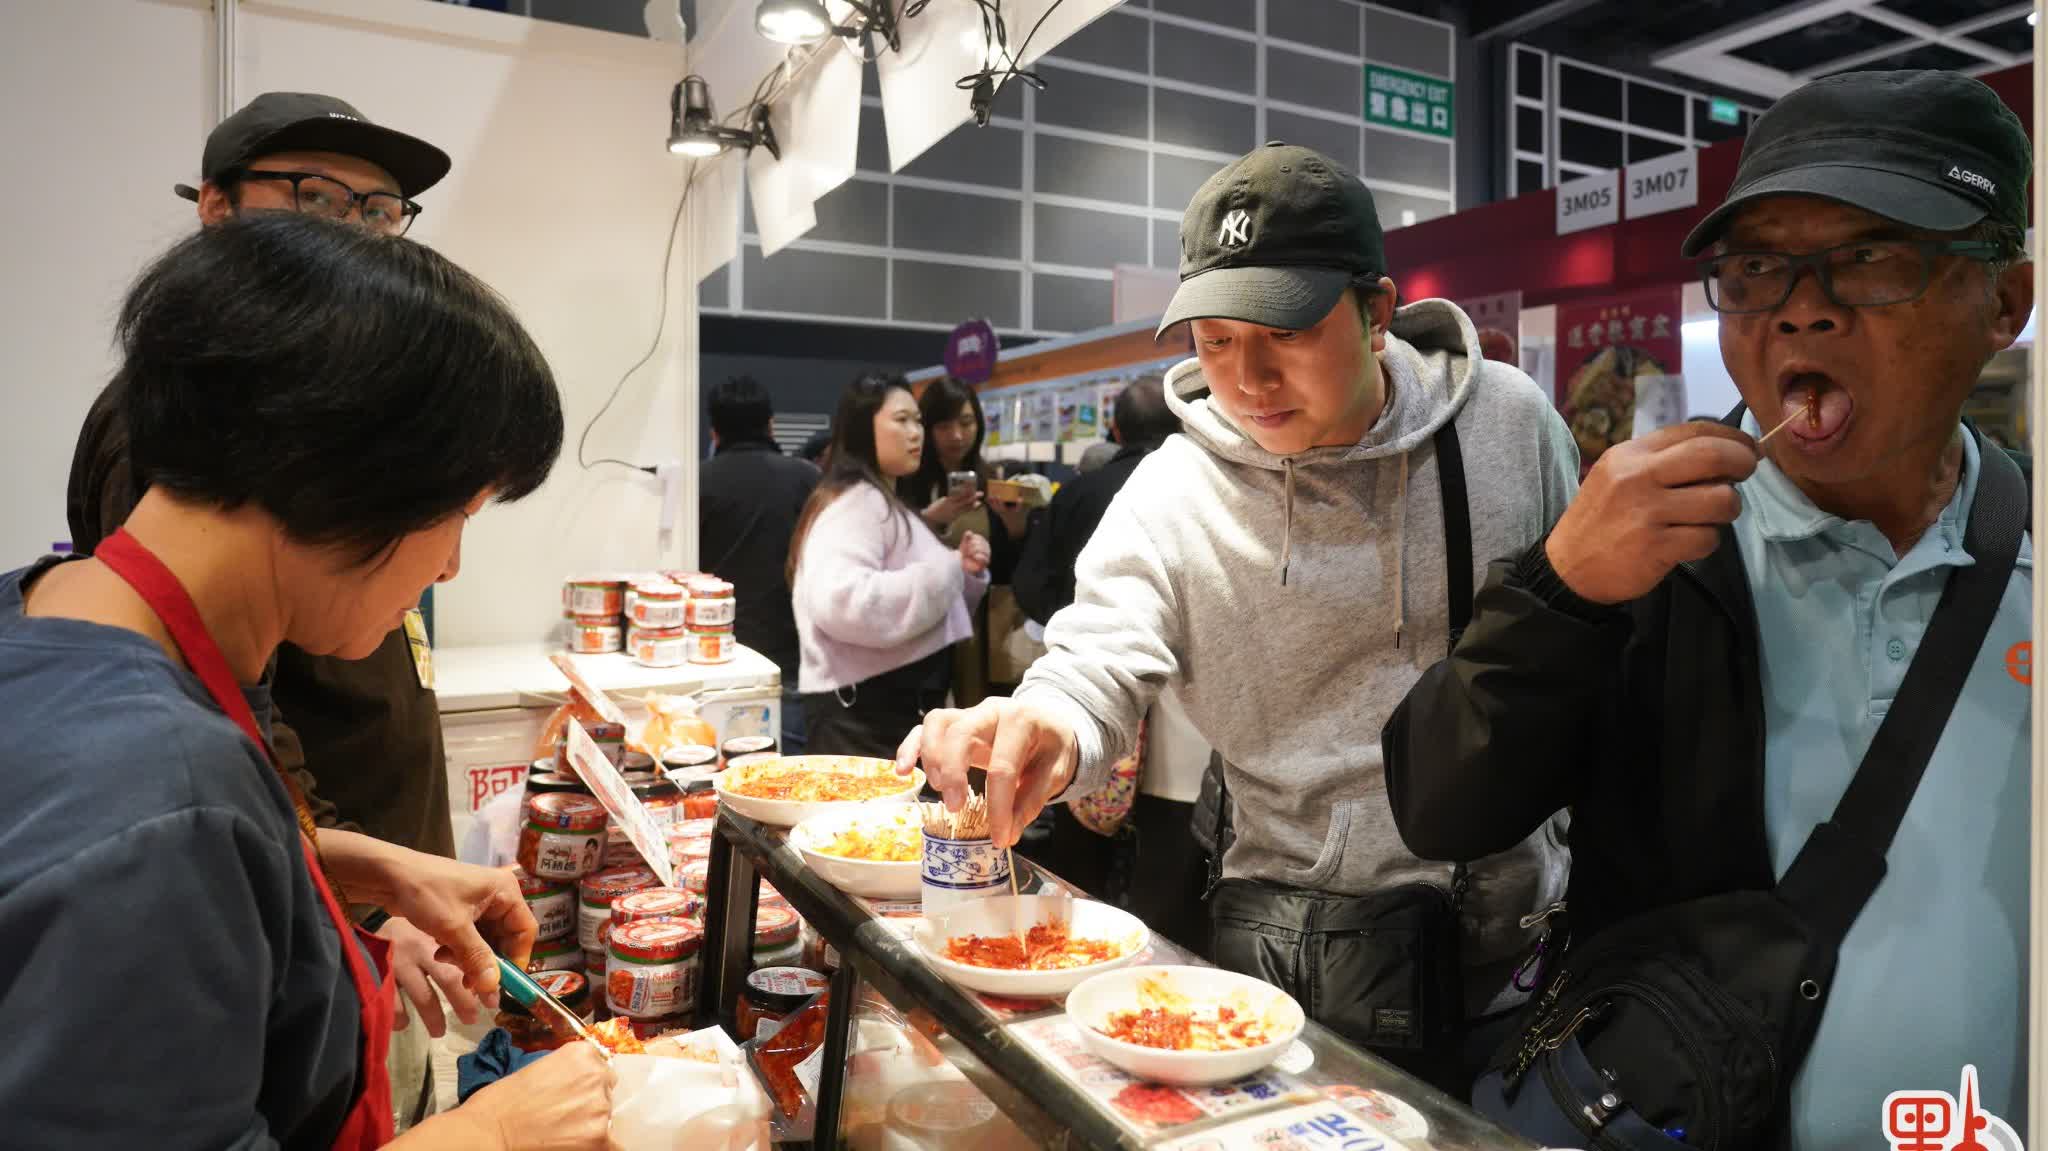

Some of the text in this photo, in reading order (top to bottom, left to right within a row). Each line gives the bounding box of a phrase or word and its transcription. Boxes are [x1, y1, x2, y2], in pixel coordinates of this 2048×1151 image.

[1632, 168, 1689, 200] 3M07
[1562, 187, 1612, 217] 3M05
[1217, 209, 1251, 246] NY
